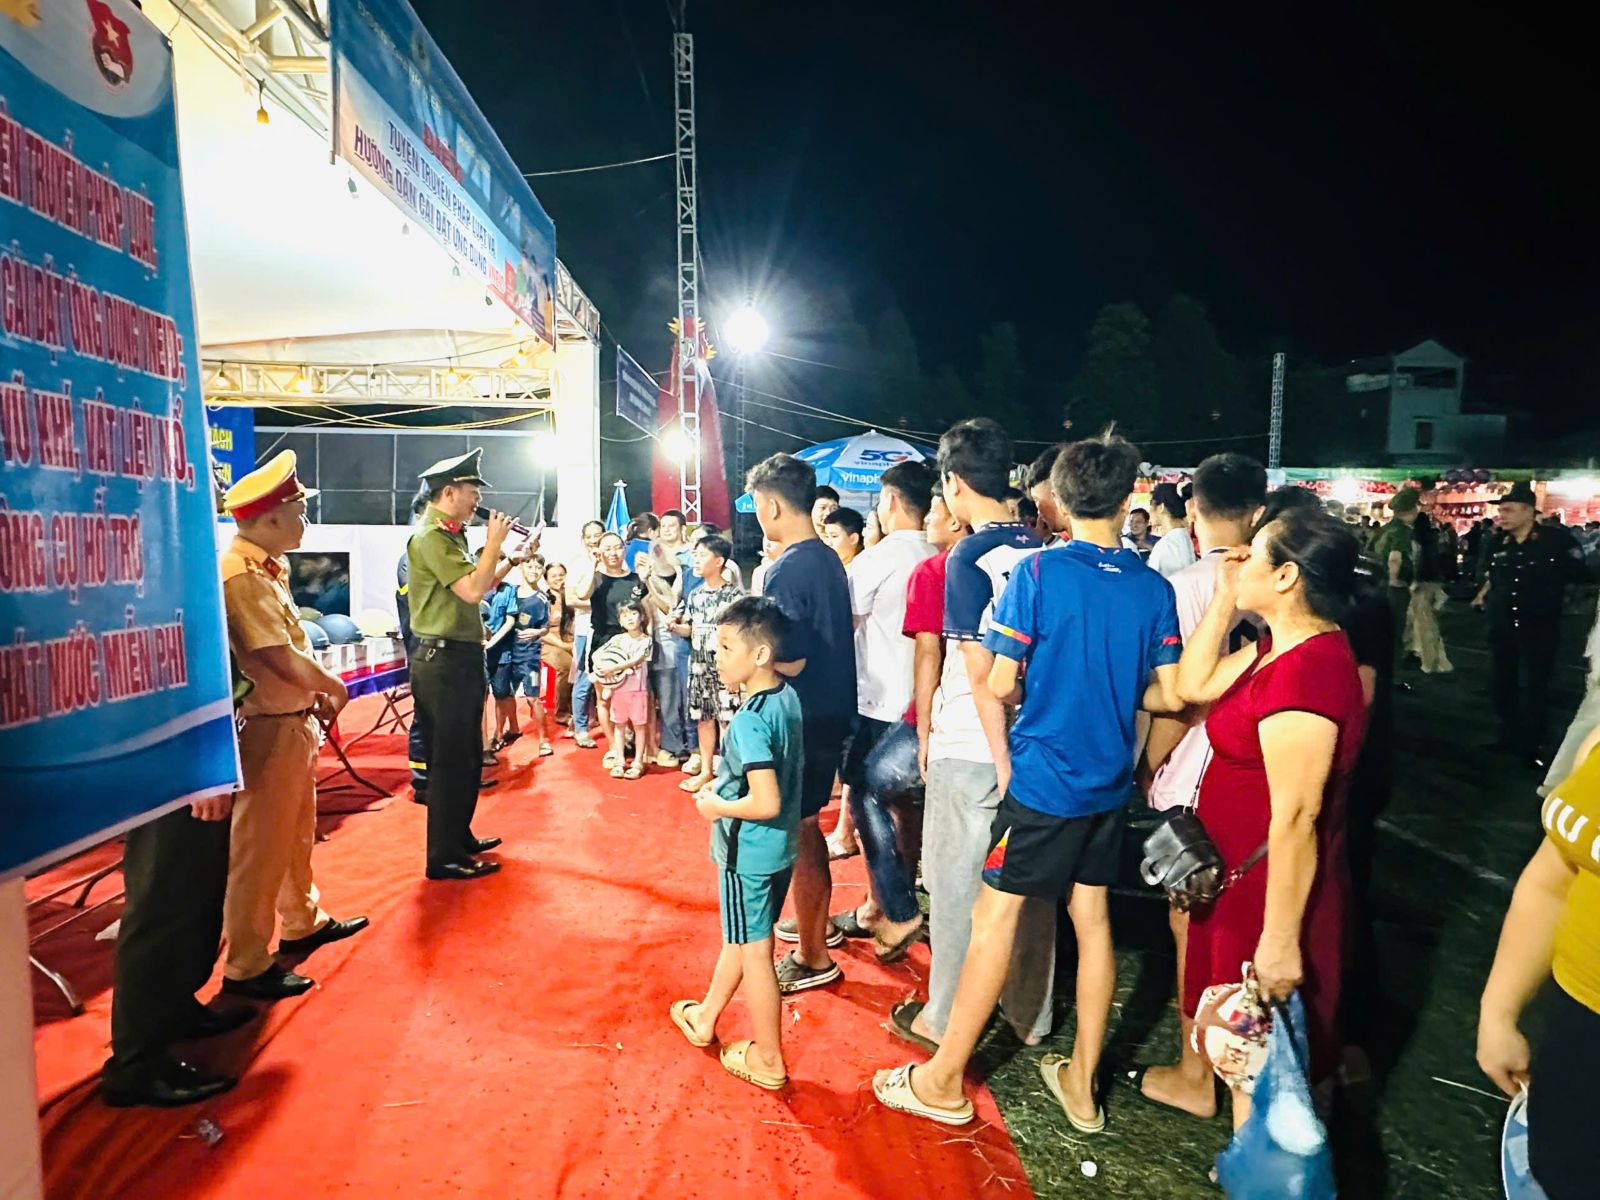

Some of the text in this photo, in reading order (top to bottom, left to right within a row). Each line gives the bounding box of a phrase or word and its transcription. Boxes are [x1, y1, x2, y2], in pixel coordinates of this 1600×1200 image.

[841, 471, 881, 486] vinaph
[0, 493, 48, 593] ÔNG
[52, 511, 79, 606] CỤ
[0, 627, 42, 730] HÁT
